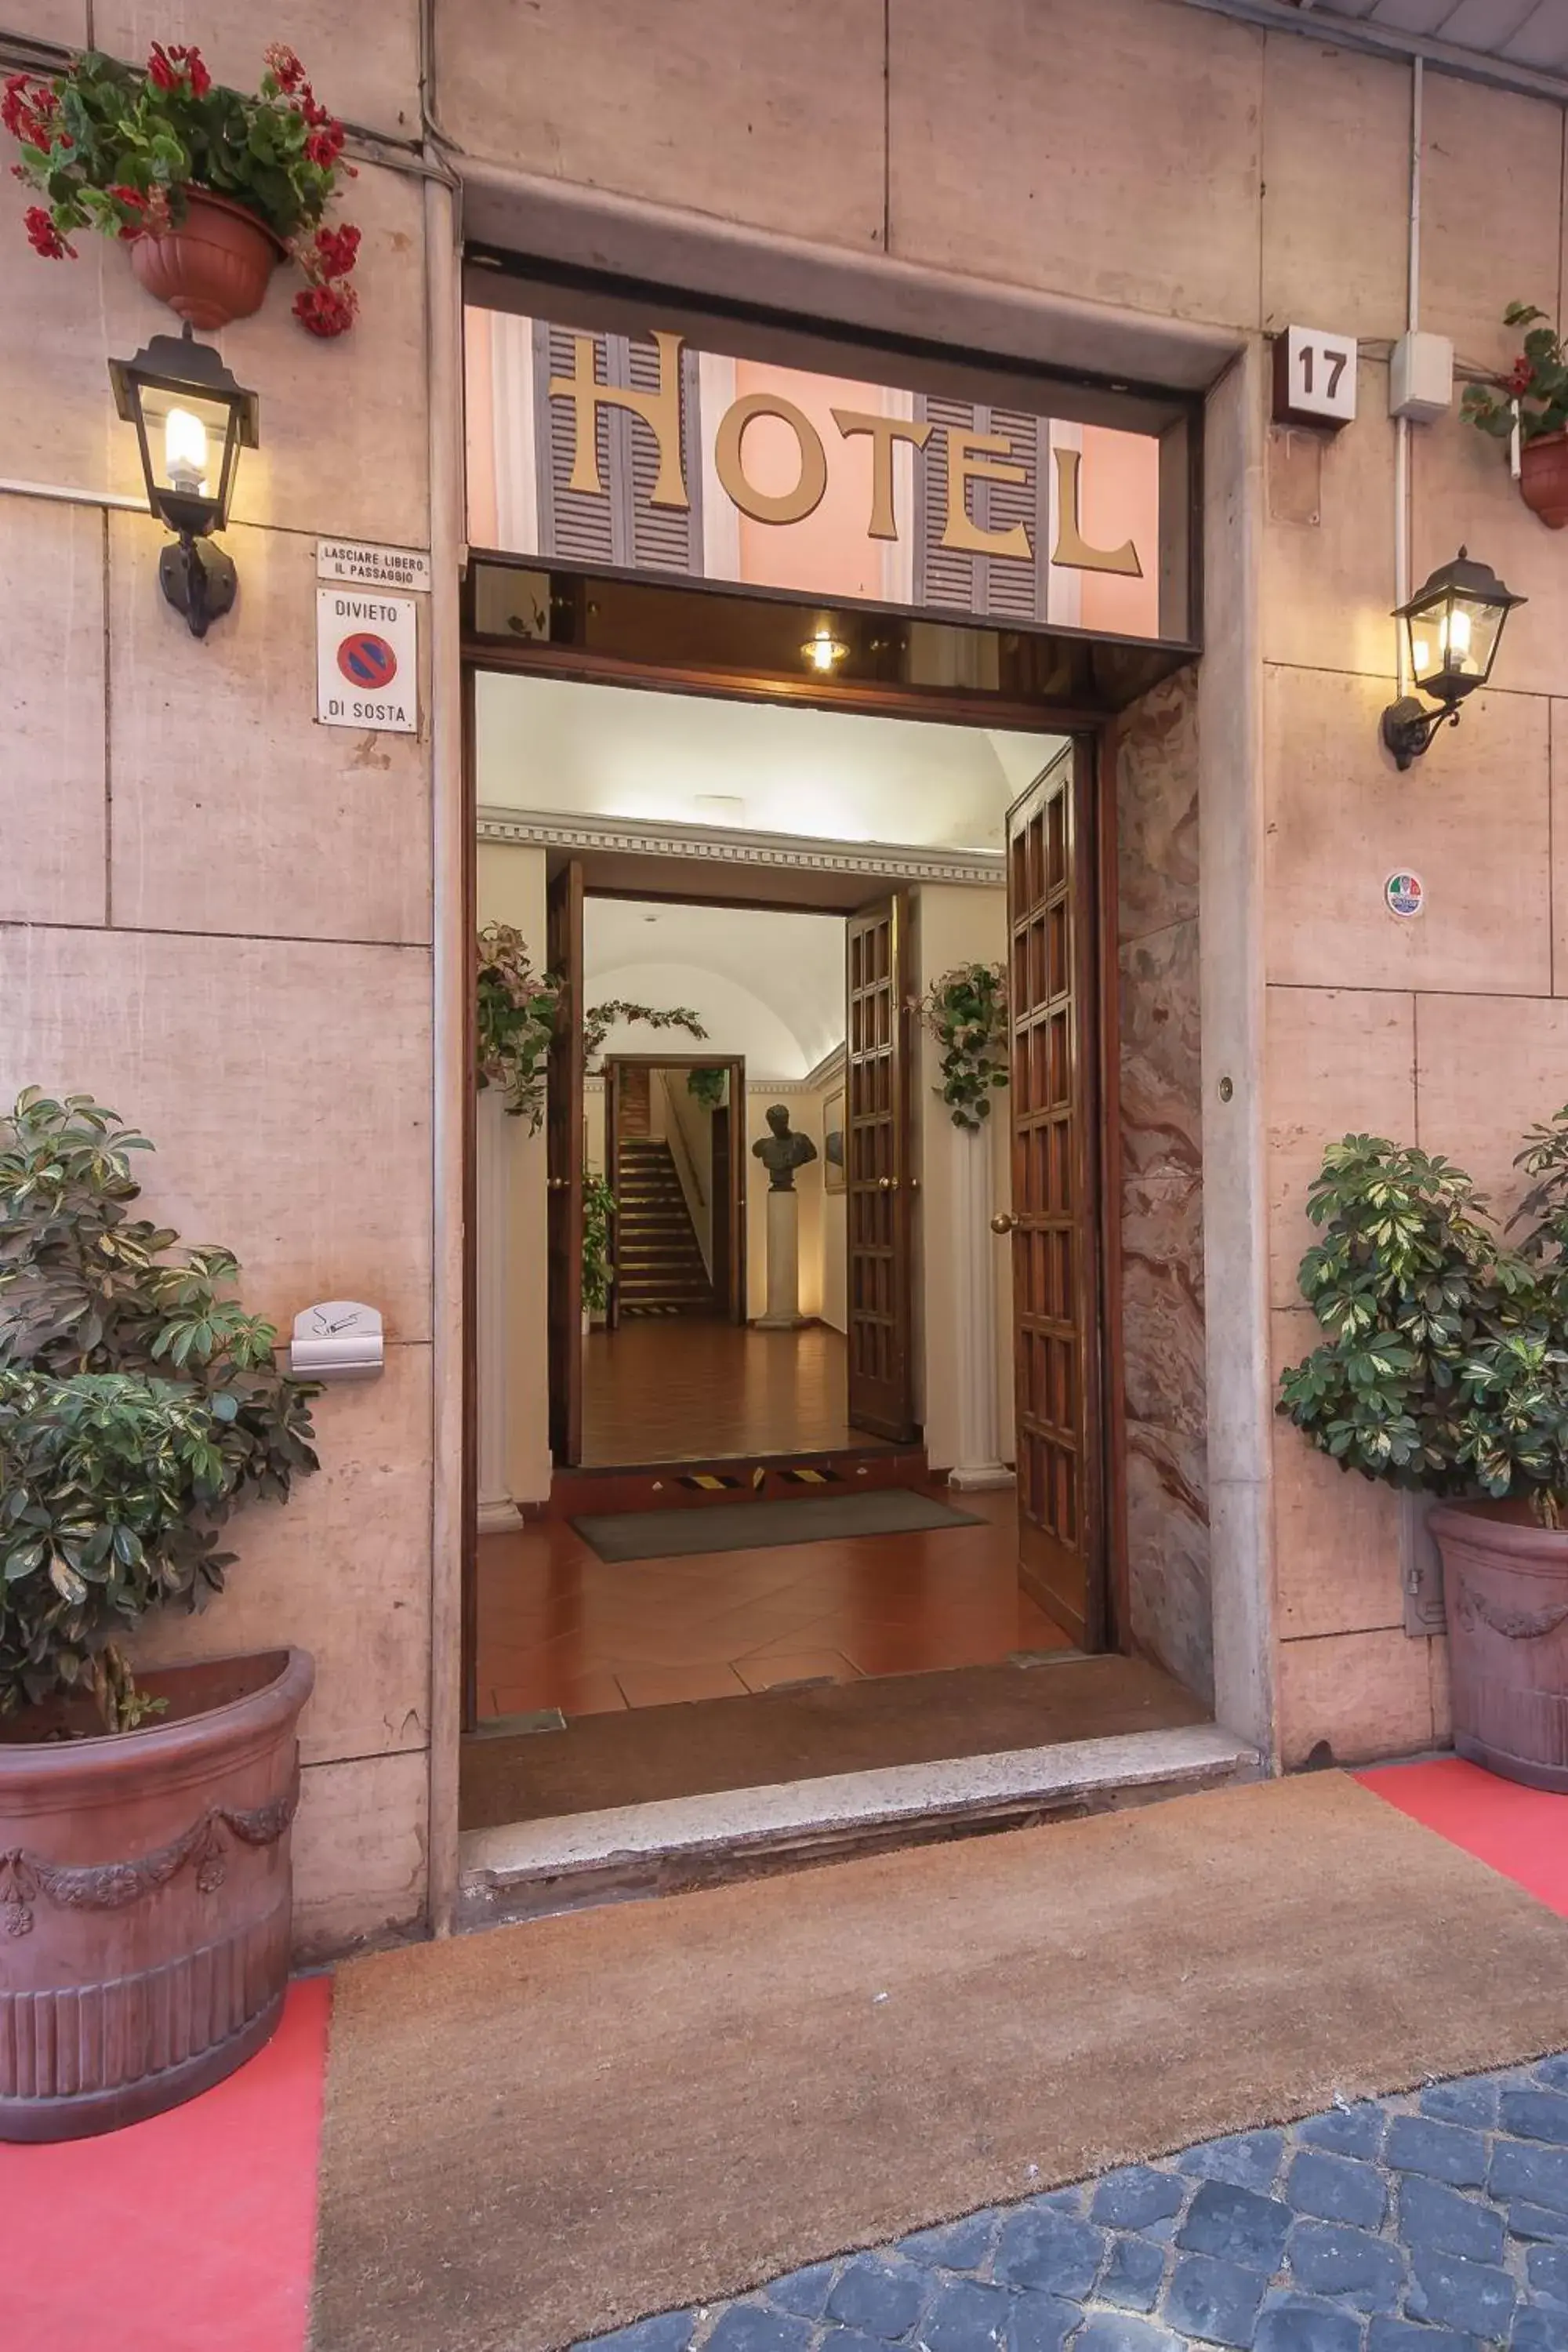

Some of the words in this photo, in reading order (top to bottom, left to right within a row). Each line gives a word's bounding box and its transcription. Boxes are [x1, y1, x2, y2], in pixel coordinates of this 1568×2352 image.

[1299, 345, 1347, 398] 17
[549, 330, 1143, 577] HOTEL
[325, 546, 379, 565] LASCIARE
[384, 554, 423, 572] LIBERO
[335, 562, 346, 575] IL
[350, 564, 414, 584] PASSAGGIO
[336, 600, 397, 622] DIVIETO
[328, 700, 344, 716] DI
[353, 703, 405, 722] SOSTA
